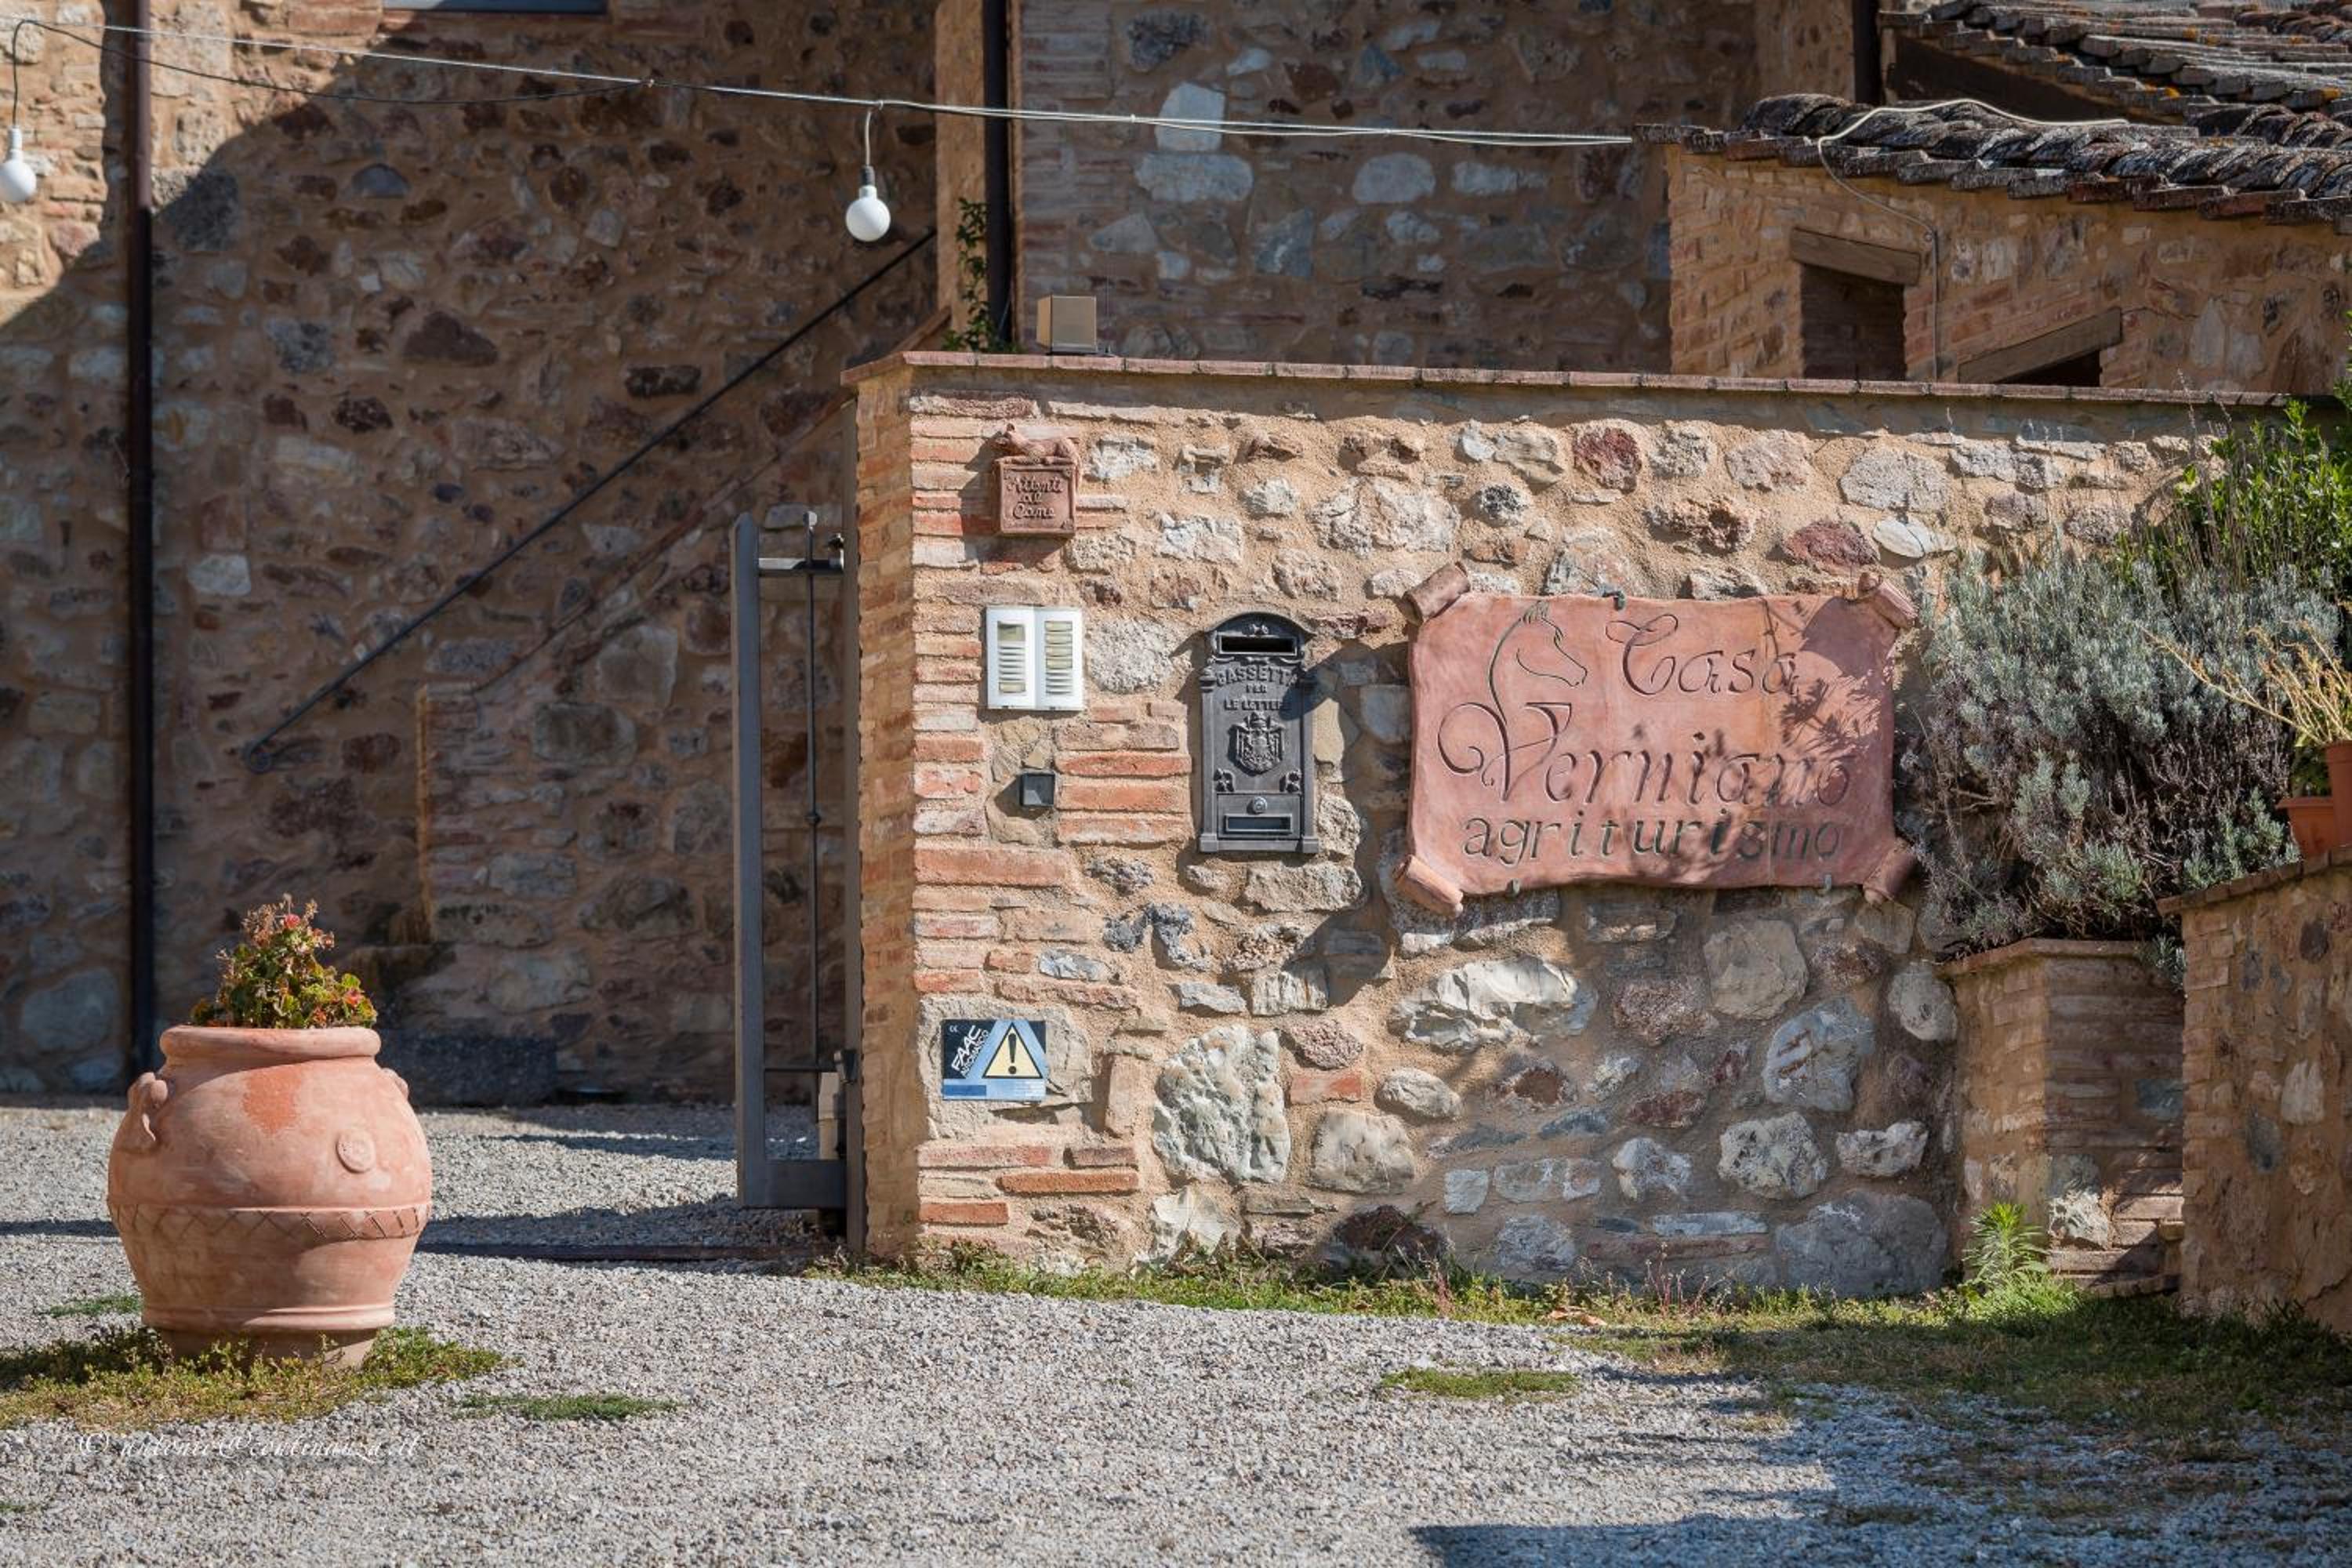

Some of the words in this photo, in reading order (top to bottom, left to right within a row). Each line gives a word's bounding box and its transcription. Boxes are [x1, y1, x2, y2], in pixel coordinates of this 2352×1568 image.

[1216, 663, 1298, 688] CASSETTA
[1605, 614, 1799, 695] Casa
[1241, 695, 1290, 711] LETTER
[1246, 682, 1268, 694] PER
[1438, 702, 1853, 804] Verniano
[1460, 810, 1841, 865] agriturismo
[951, 1025, 981, 1072] FAAC
